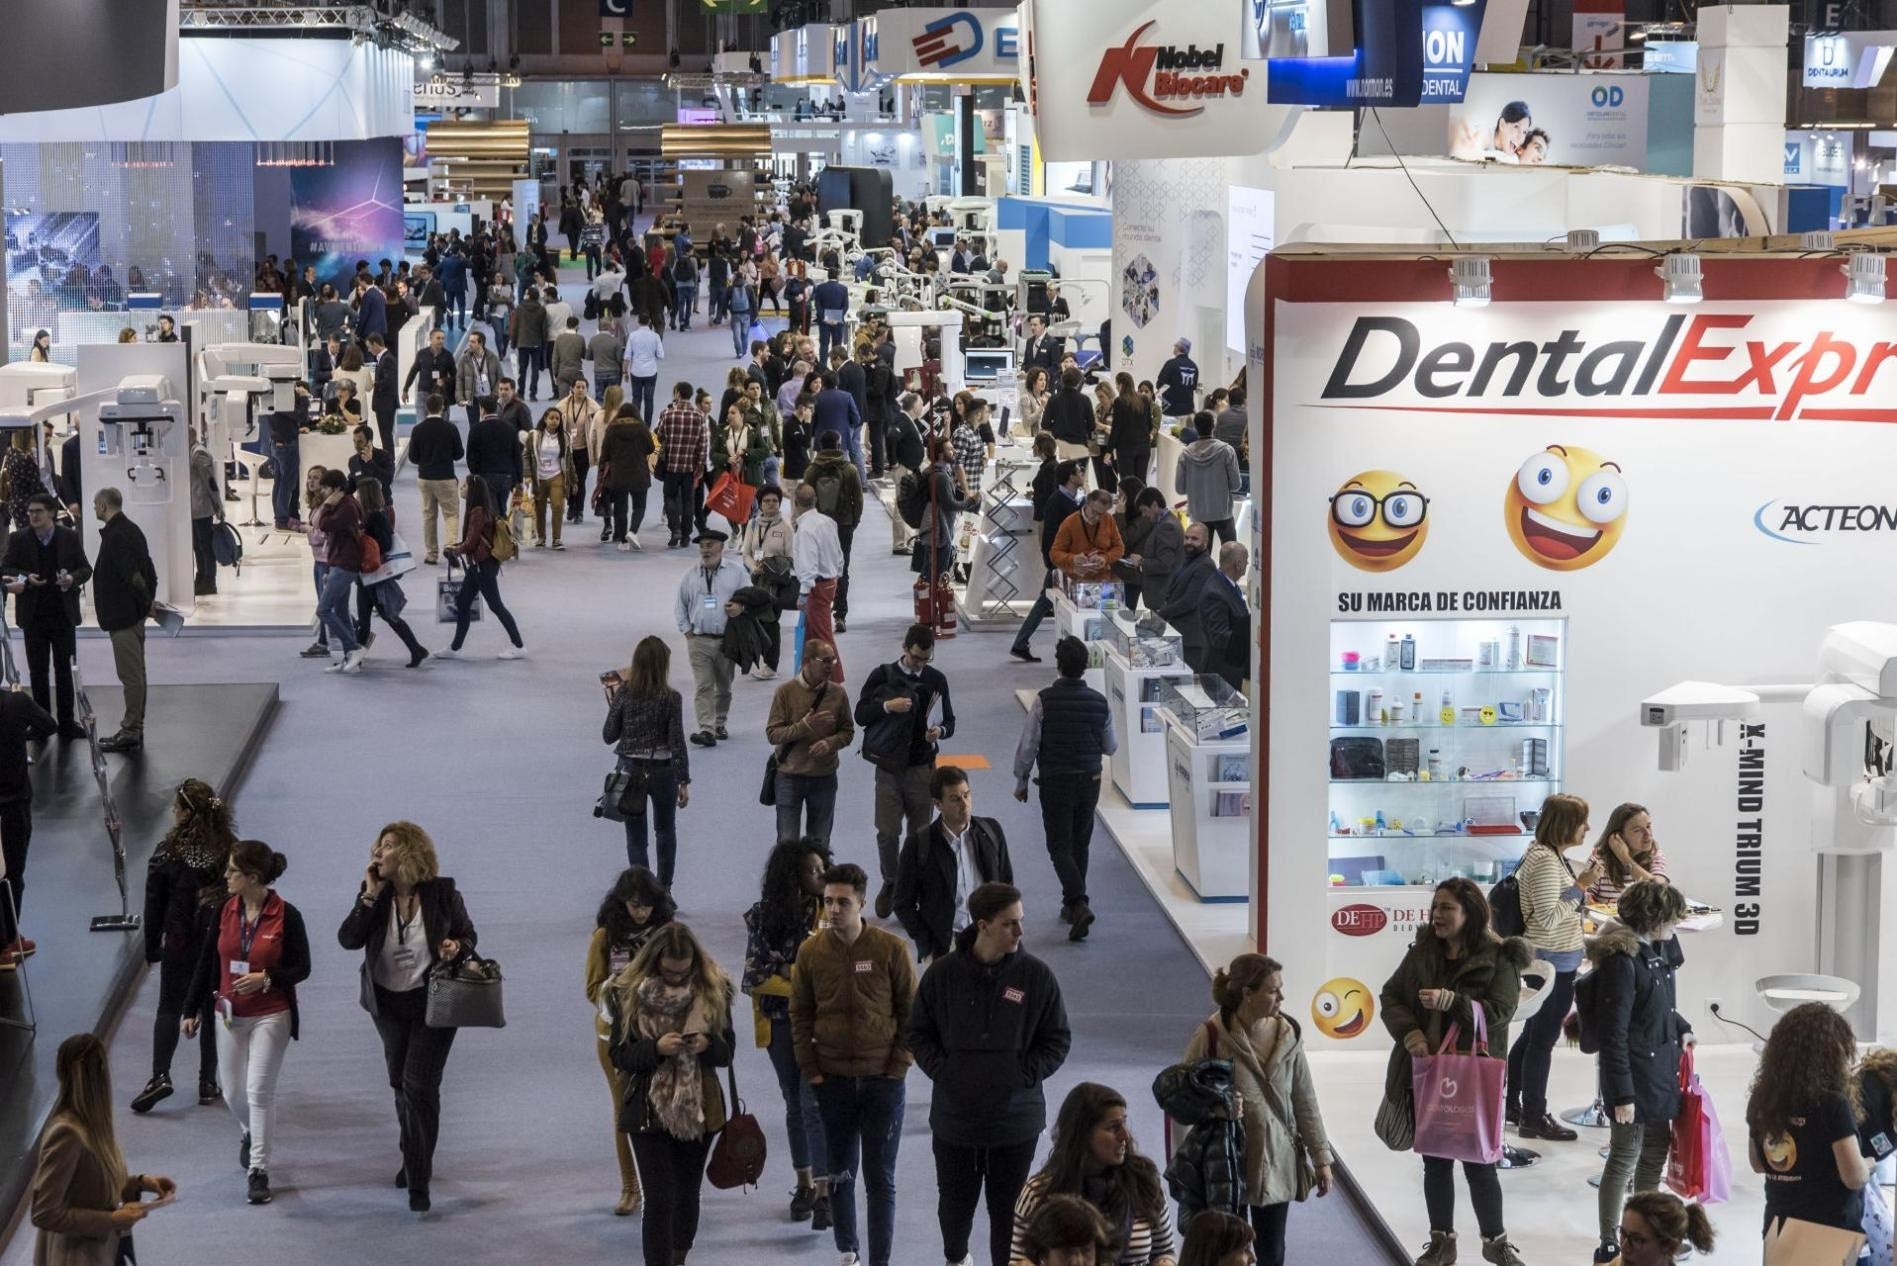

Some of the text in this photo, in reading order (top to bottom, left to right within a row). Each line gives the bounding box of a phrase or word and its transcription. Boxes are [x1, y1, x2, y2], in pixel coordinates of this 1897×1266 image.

[1825, 3, 1840, 27] E
[1156, 43, 1224, 70] Nobel
[1422, 31, 1464, 64] ON
[1808, 67, 1848, 77] DENTAURUM
[1346, 78, 1393, 98] www.normon.es
[1421, 79, 1462, 97] DENTAL
[1591, 85, 1624, 108] OD
[1779, 504, 1897, 532] ACTEON
[1338, 590, 1562, 612] SU MARCA DE CONFIANZA
[1734, 723, 1766, 936] X-MIND TRIUM 3D
[1393, 909, 1415, 921] DE
